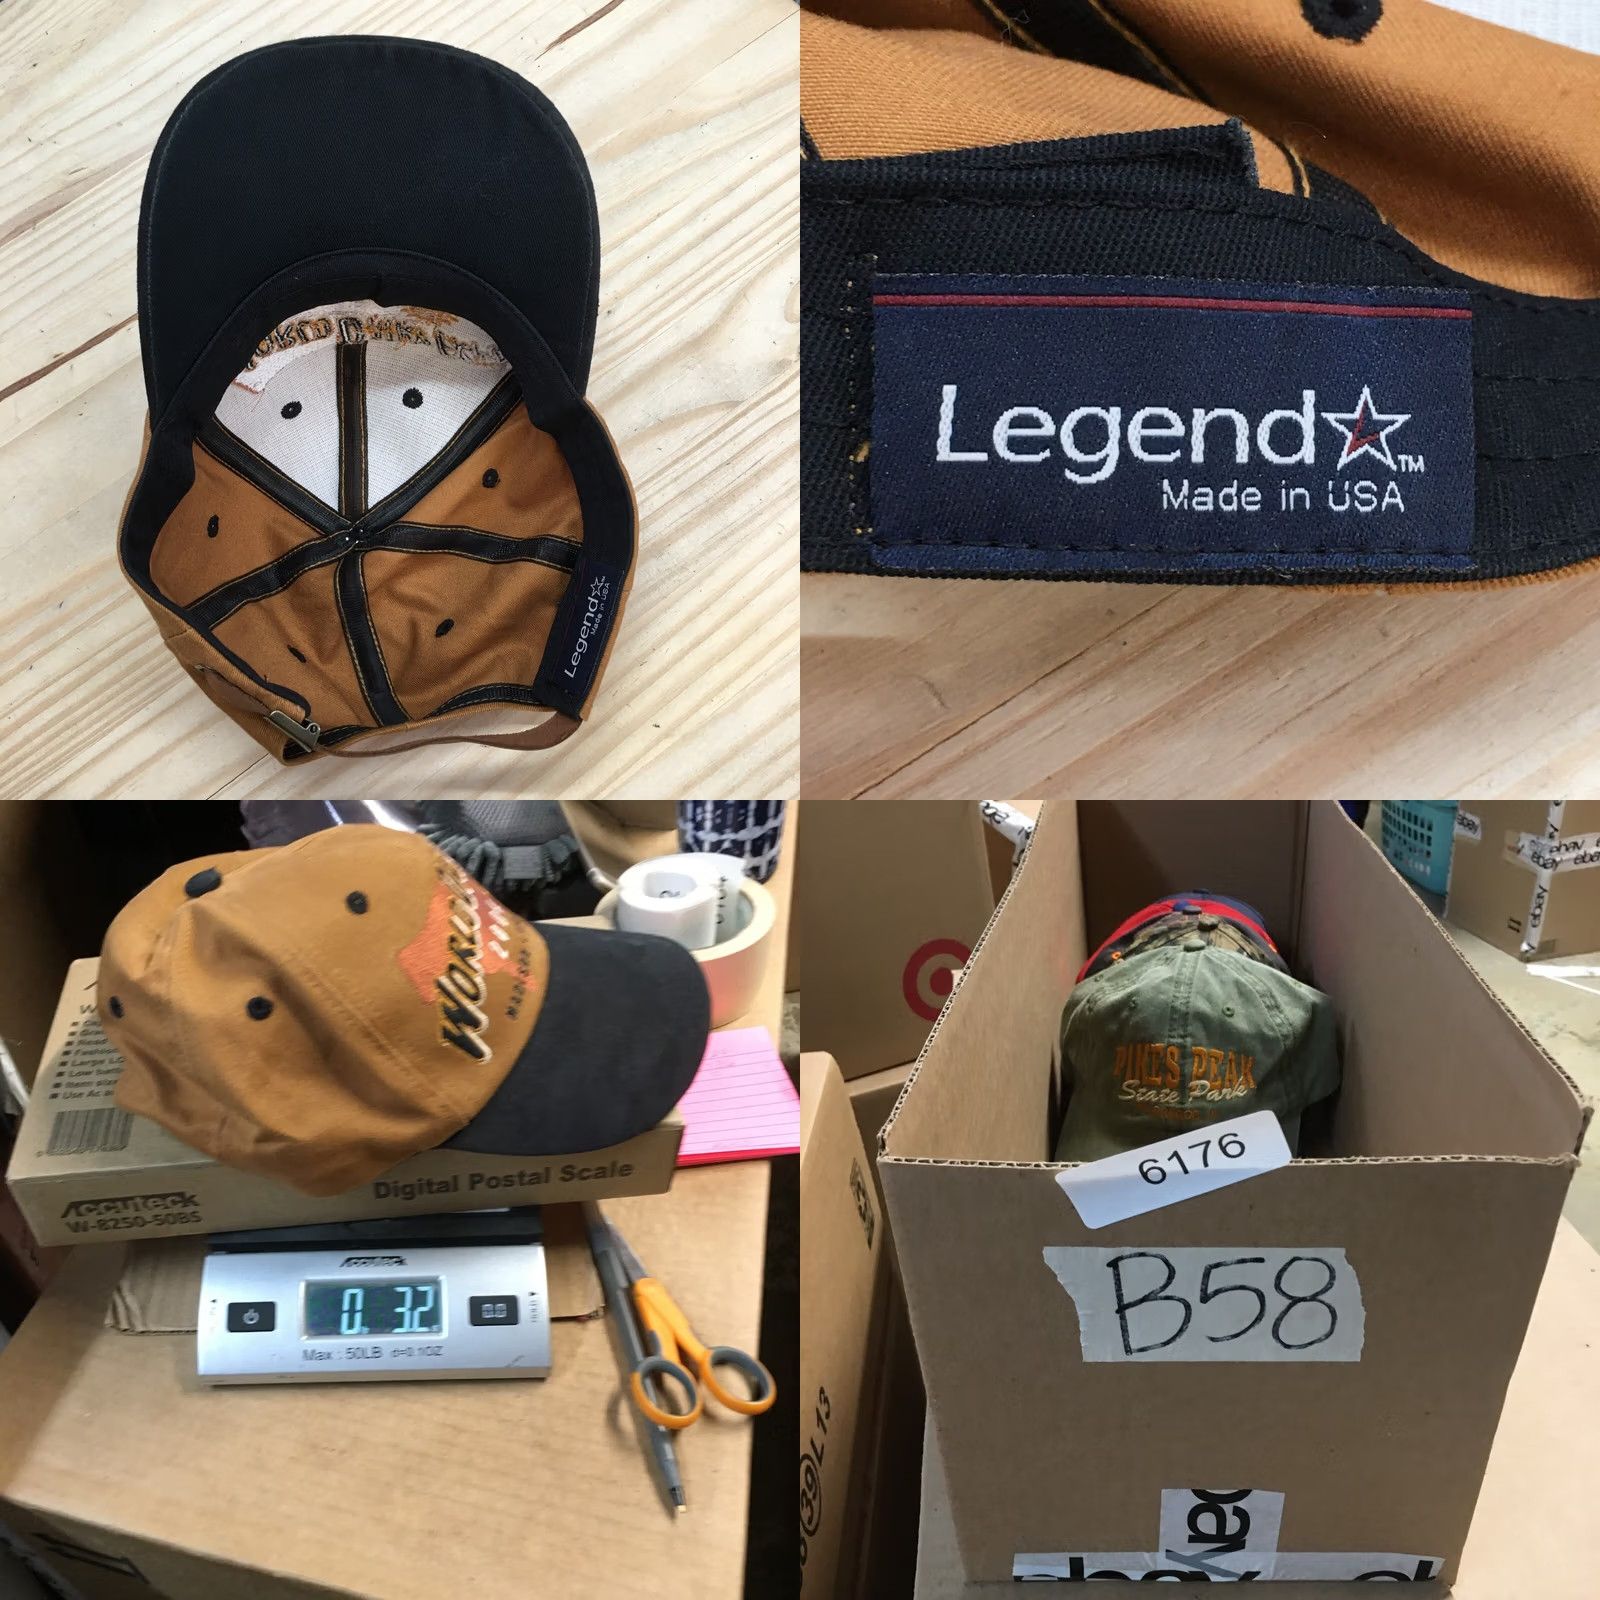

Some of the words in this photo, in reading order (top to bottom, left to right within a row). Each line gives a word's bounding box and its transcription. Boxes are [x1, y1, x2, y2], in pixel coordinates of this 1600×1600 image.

[936, 384, 1316, 484] Legend
[1162, 479, 1260, 512] Made
[1280, 480, 1311, 511] in
[1328, 480, 1406, 513] USA
[590, 613, 603, 635] Made
[601, 582, 611, 600] USA
[564, 597, 599, 678] Legend
[1118, 1079, 1180, 1102] State
[1188, 1076, 1248, 1101] Park
[1190, 1046, 1257, 1088] PEAK
[374, 1174, 458, 1201] Digital
[468, 1166, 551, 1191] Postal
[559, 1159, 635, 1183] Scale
[1138, 1133, 1246, 1185] 6176
[1106, 1251, 1338, 1356] B58
